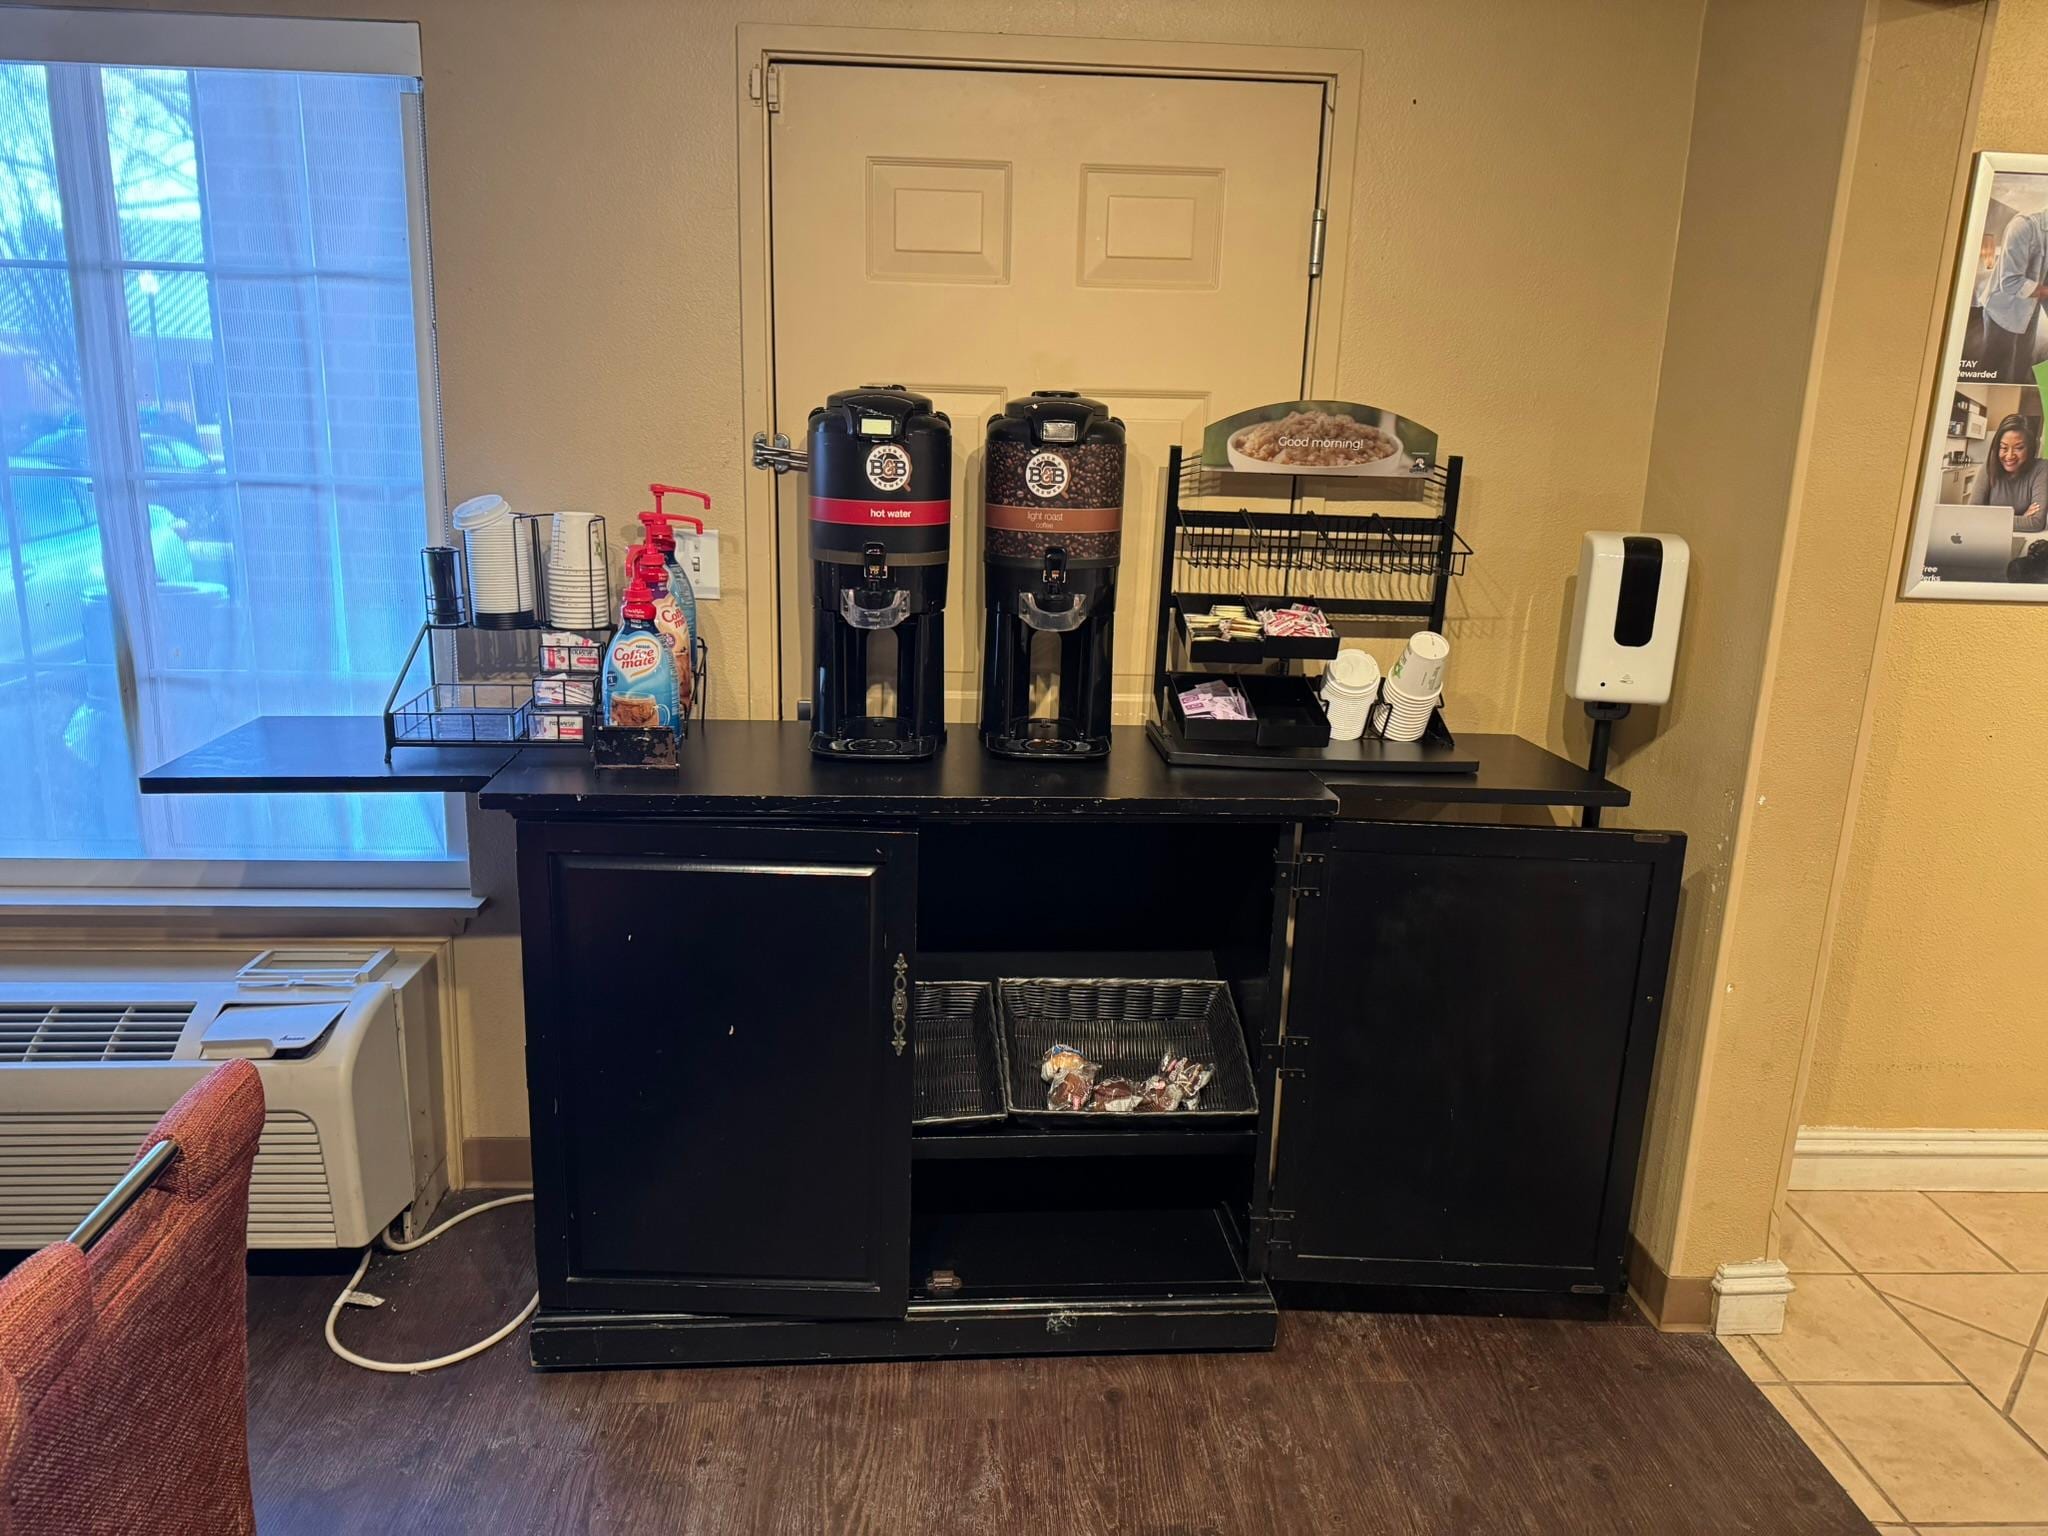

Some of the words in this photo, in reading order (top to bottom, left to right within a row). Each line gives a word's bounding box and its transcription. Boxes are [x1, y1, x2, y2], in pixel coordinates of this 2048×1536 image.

[1959, 370, 1998, 379] ewarded
[1278, 436, 1310, 447] Good
[1311, 439, 1364, 451] morning!
[870, 508, 886, 518] hot
[886, 509, 912, 519] water
[1027, 511, 1043, 522] light
[1044, 513, 1064, 521] roast
[614, 647, 654, 661] Coffee
[621, 656, 656, 669] mate
